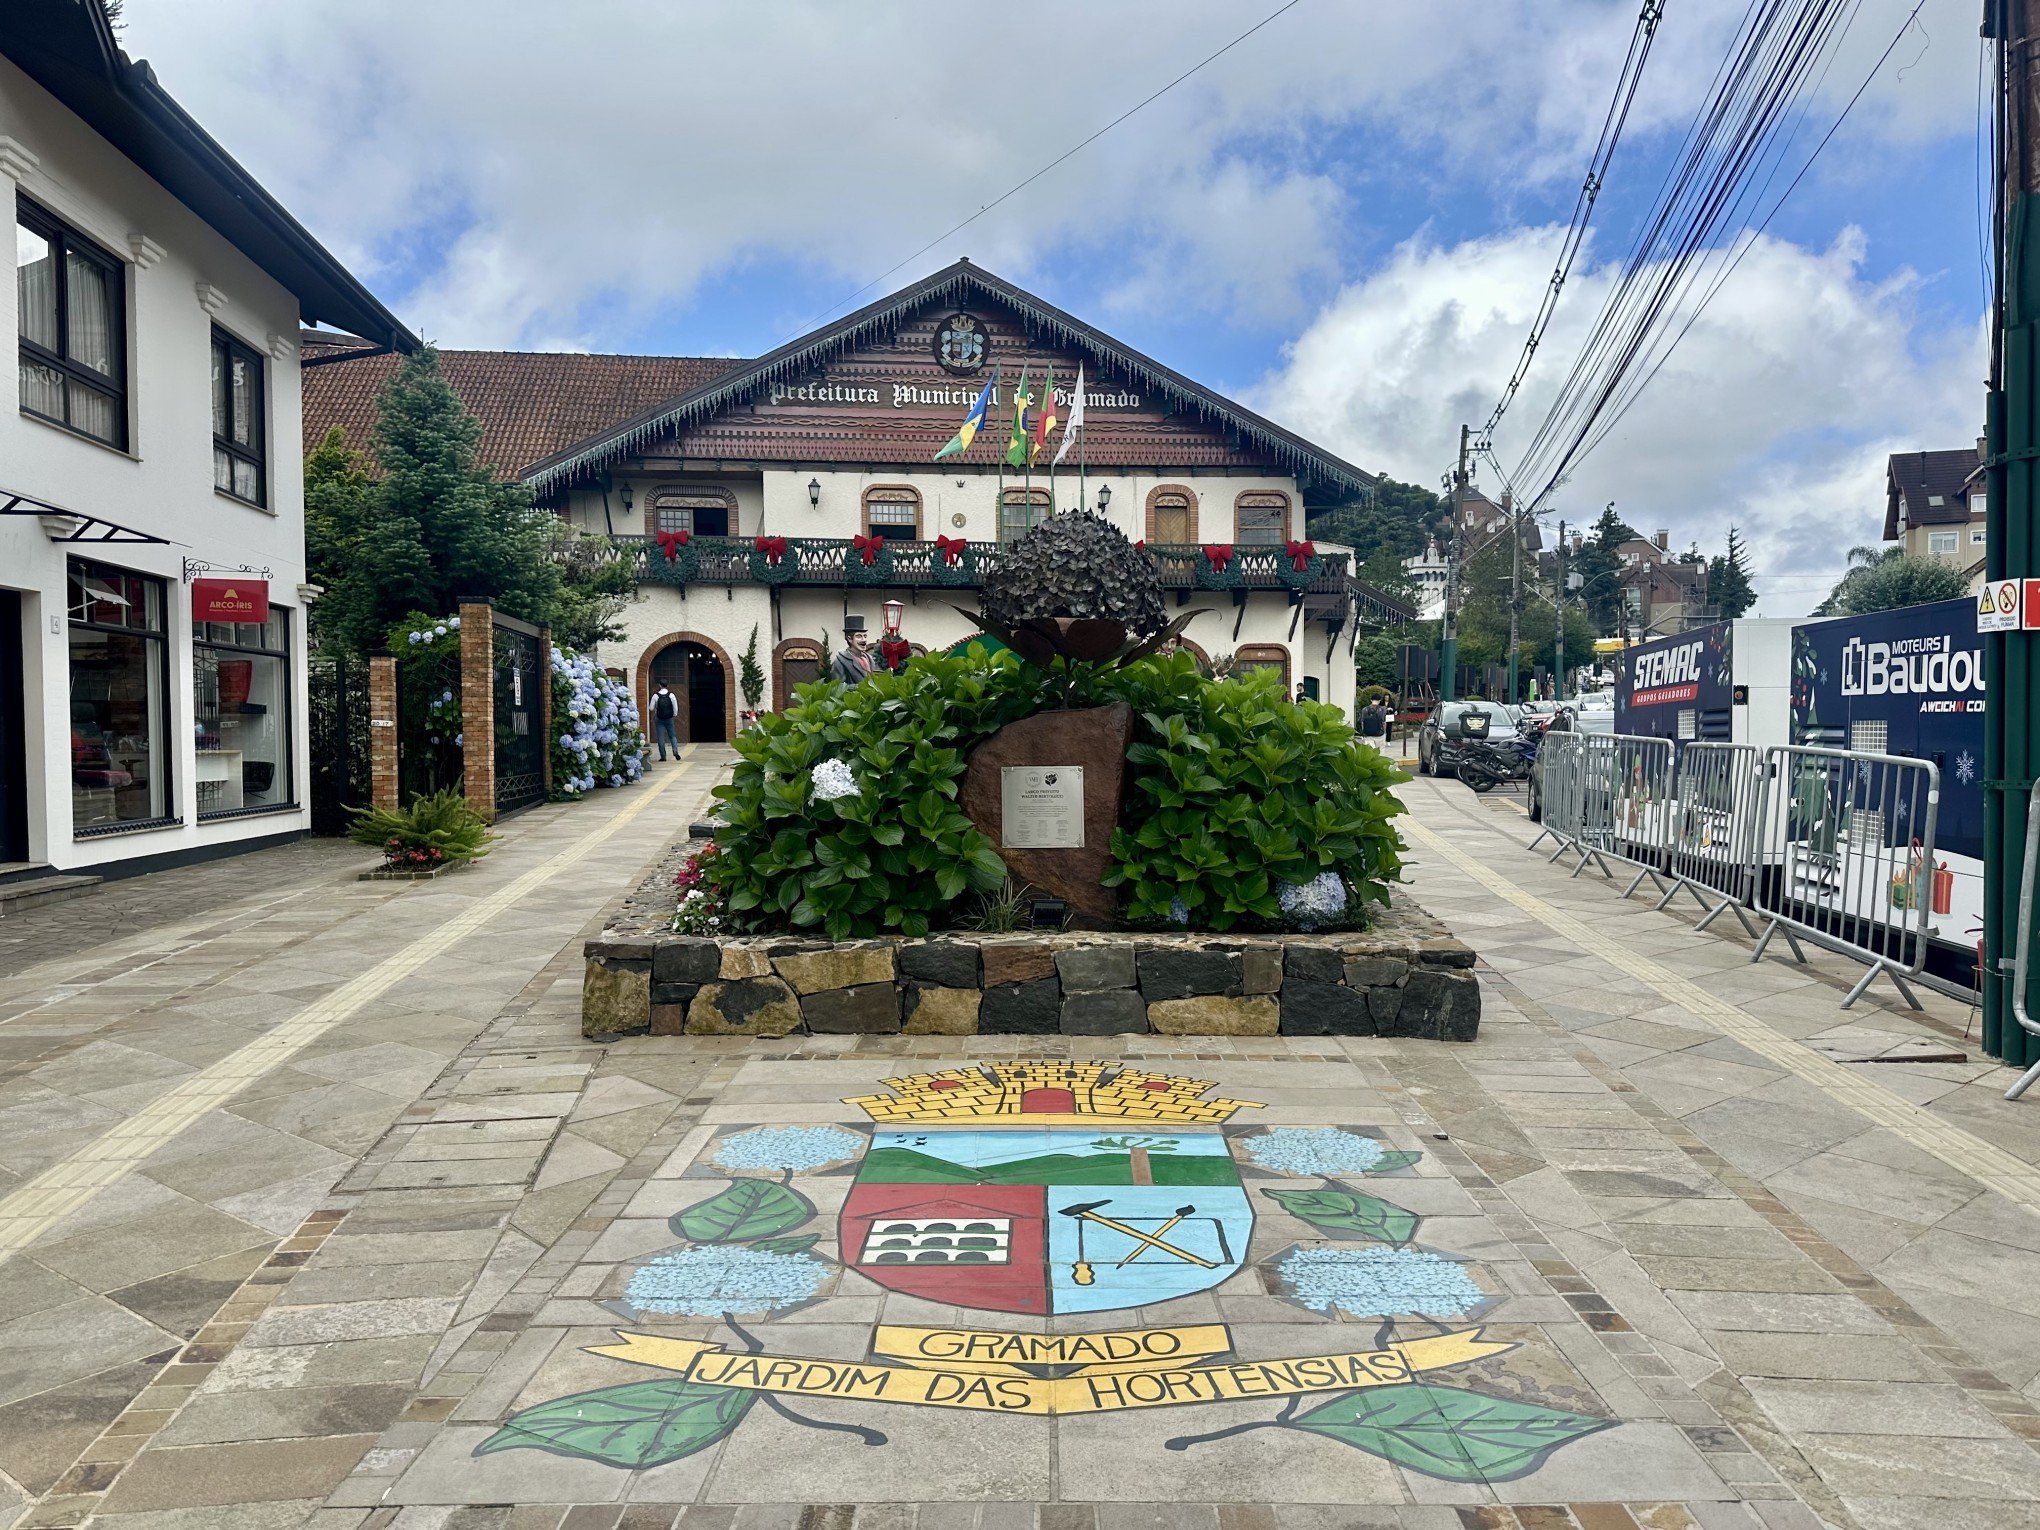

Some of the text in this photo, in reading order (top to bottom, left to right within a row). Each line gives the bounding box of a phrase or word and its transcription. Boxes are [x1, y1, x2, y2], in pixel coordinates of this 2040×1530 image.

[770, 381, 879, 405] Prefeitura
[893, 383, 998, 410] Municipl
[1053, 386, 1140, 407] Grmado
[1892, 636, 1941, 655] MOTEURS
[1633, 640, 1704, 691] STEMAC
[1636, 688, 1691, 703] GRUPOS GERADORES
[1966, 700, 1986, 712] CO
[918, 1331, 1181, 1362] GRAMADO
[696, 1354, 1409, 1409] JARDIM DAS HORTÊNSIAS
